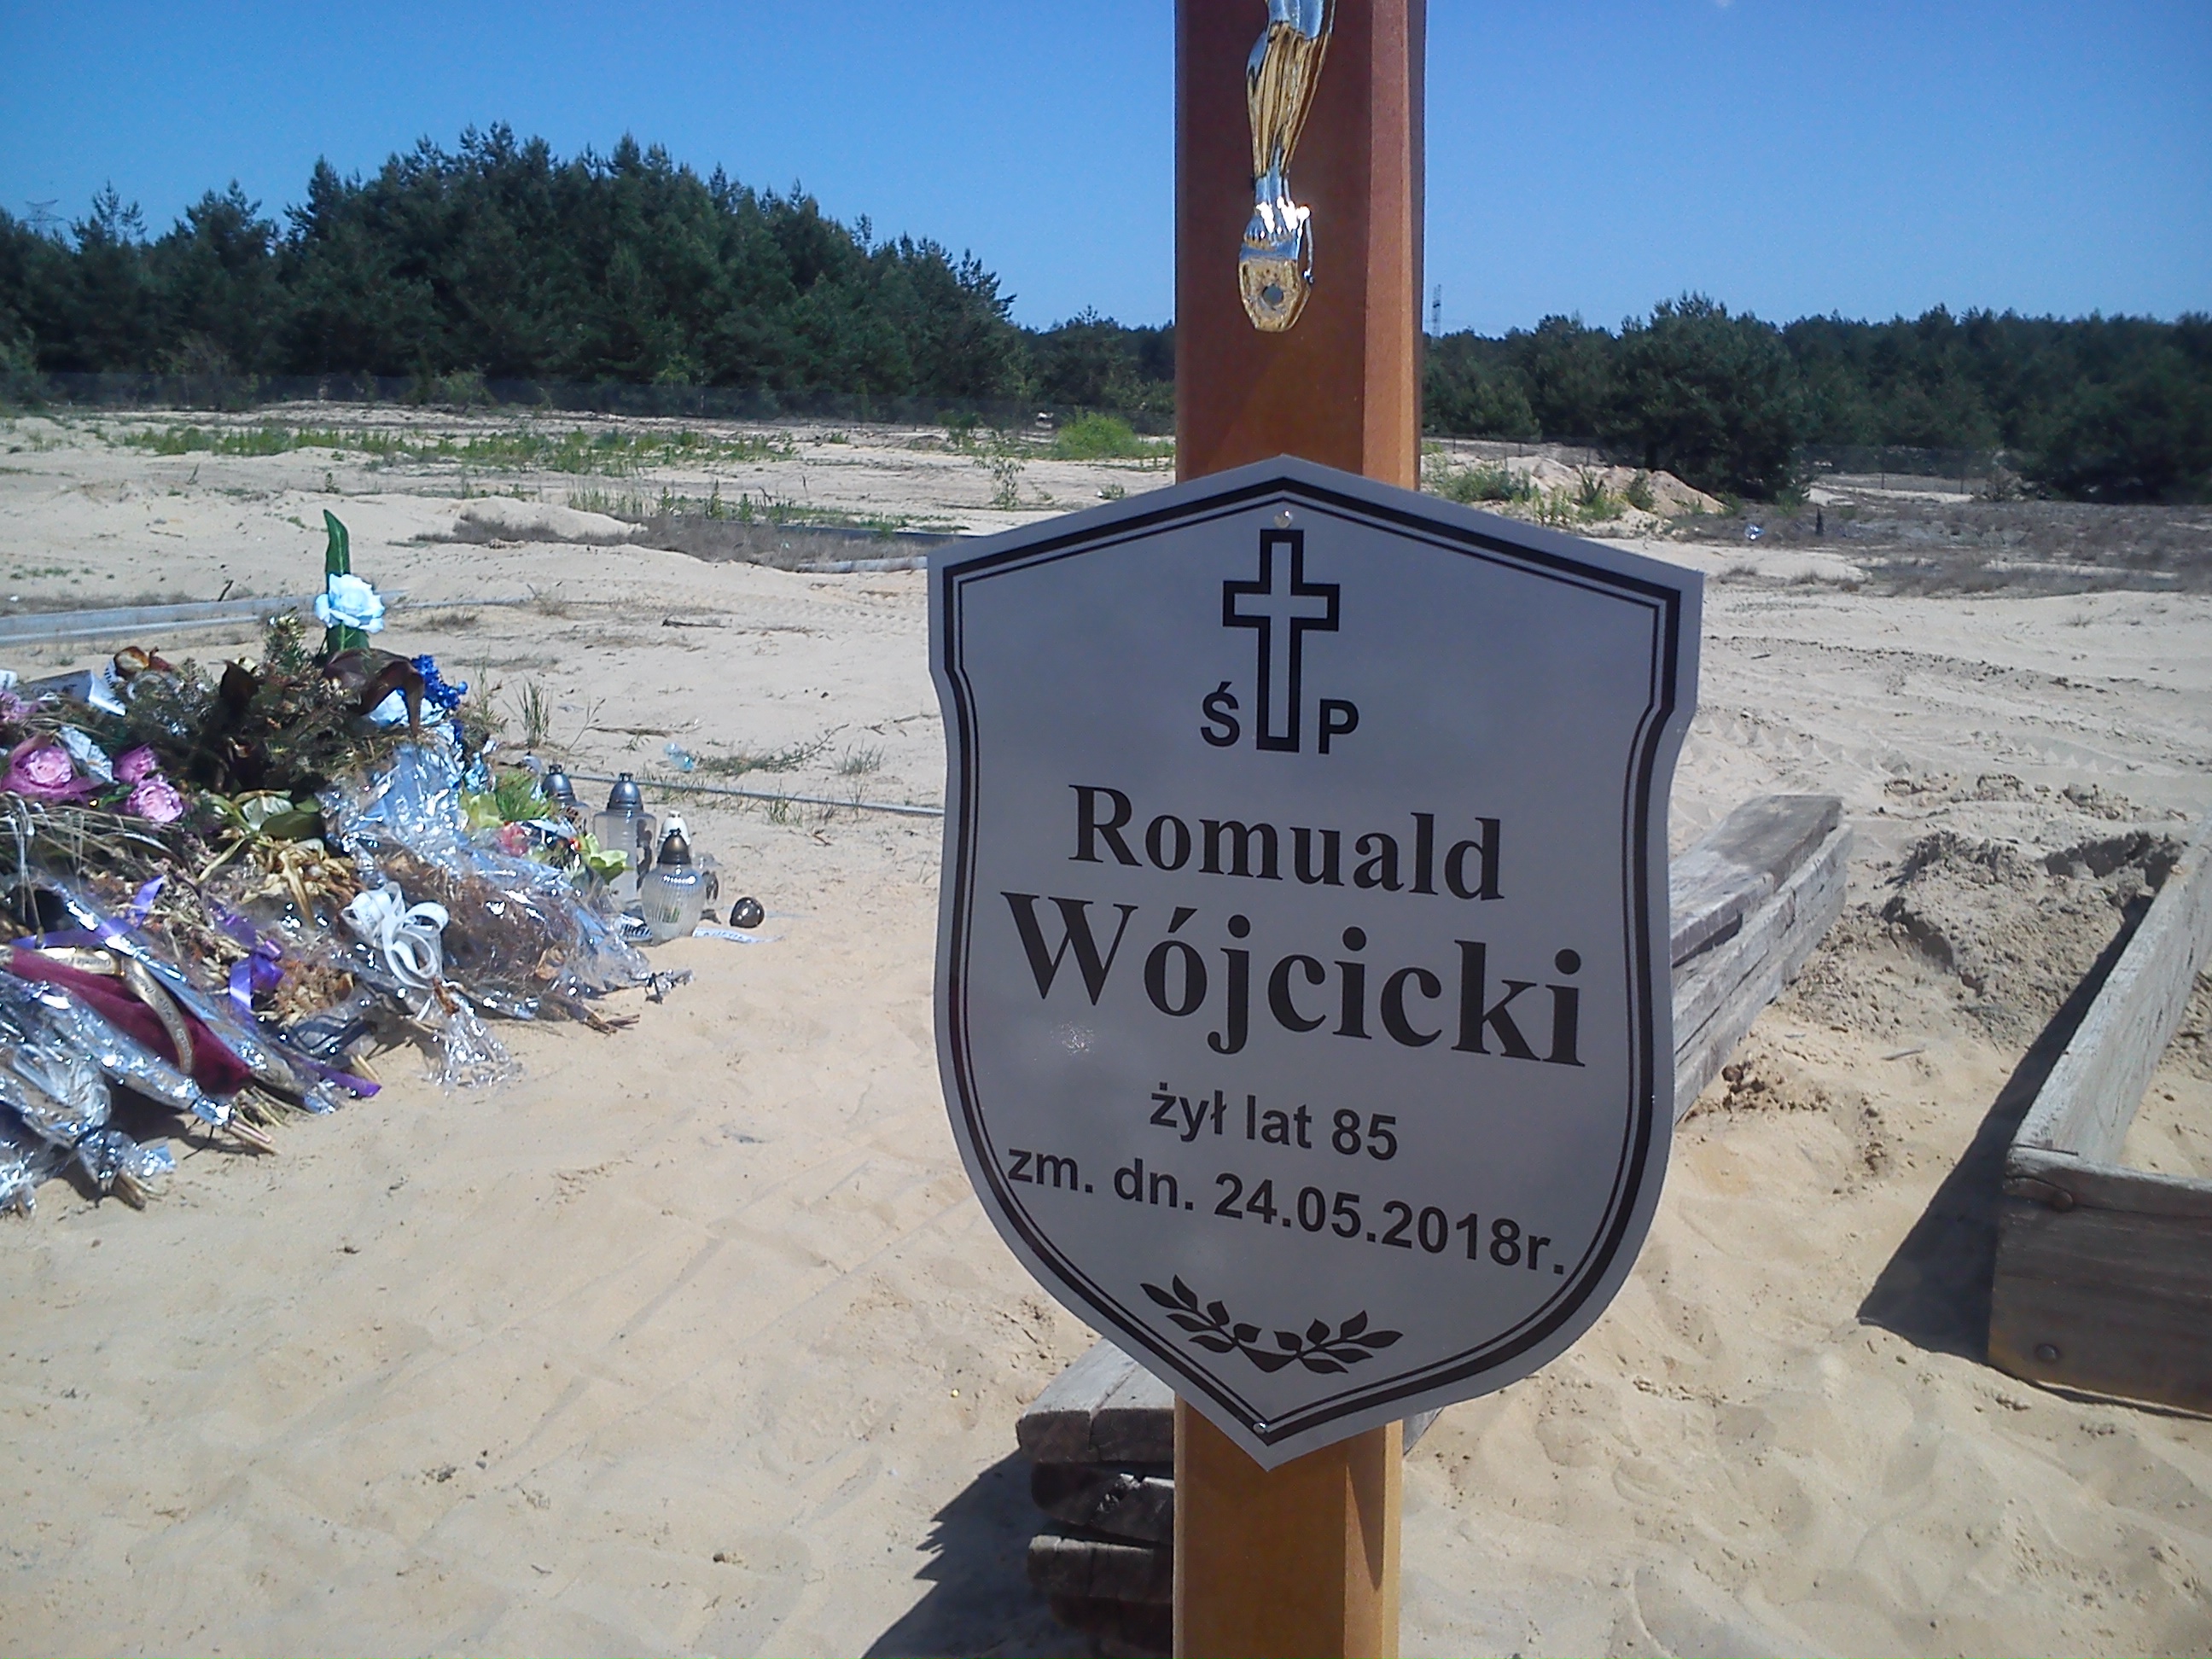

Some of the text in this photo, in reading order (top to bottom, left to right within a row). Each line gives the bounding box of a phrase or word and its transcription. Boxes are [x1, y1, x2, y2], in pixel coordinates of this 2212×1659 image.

[1200, 681, 1360, 756] Ś P
[1068, 783, 1505, 902] Romuald
[1000, 891, 1586, 1068] Wójcicki
[1150, 1081, 1399, 1161] żył lat 85
[1007, 1148, 1566, 1277] zm. dn. 24.05.2018r.
